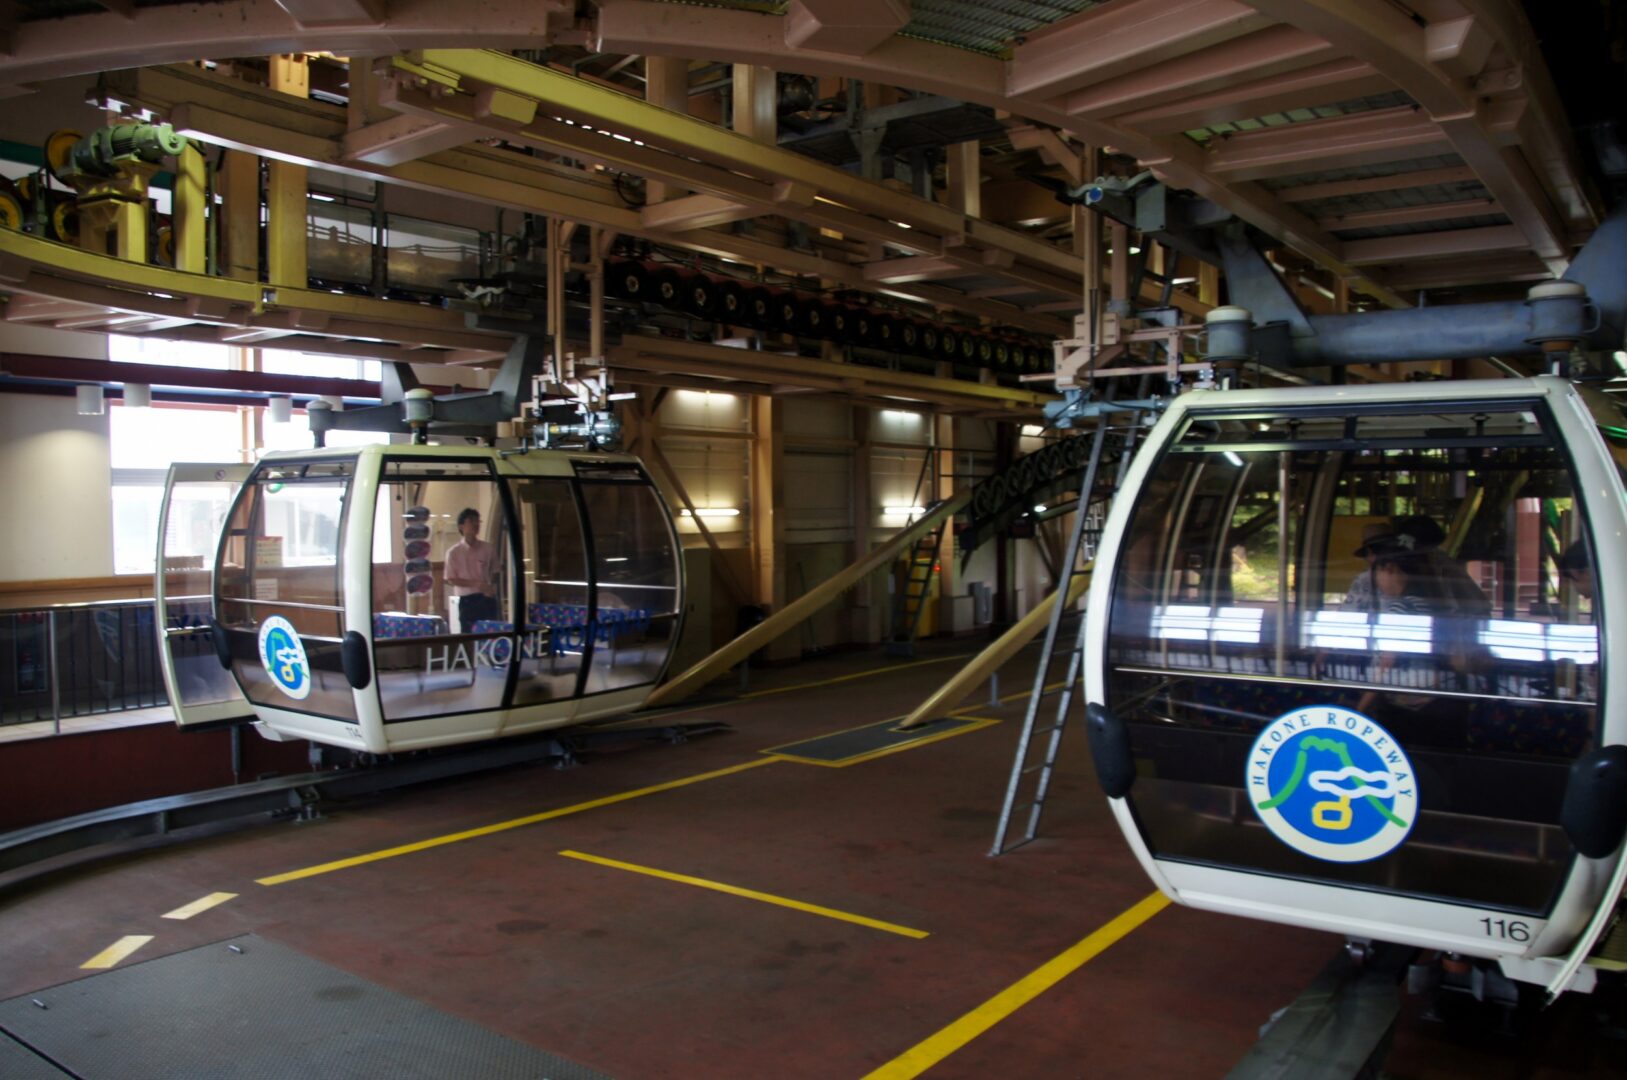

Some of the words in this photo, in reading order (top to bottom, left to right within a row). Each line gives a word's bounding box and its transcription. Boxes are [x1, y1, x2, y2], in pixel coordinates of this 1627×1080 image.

[426, 629, 549, 674] HAKONE
[1253, 714, 1310, 785] HAKONE
[1327, 712, 1412, 797] ROPEWAY
[1480, 917, 1530, 942] 116
